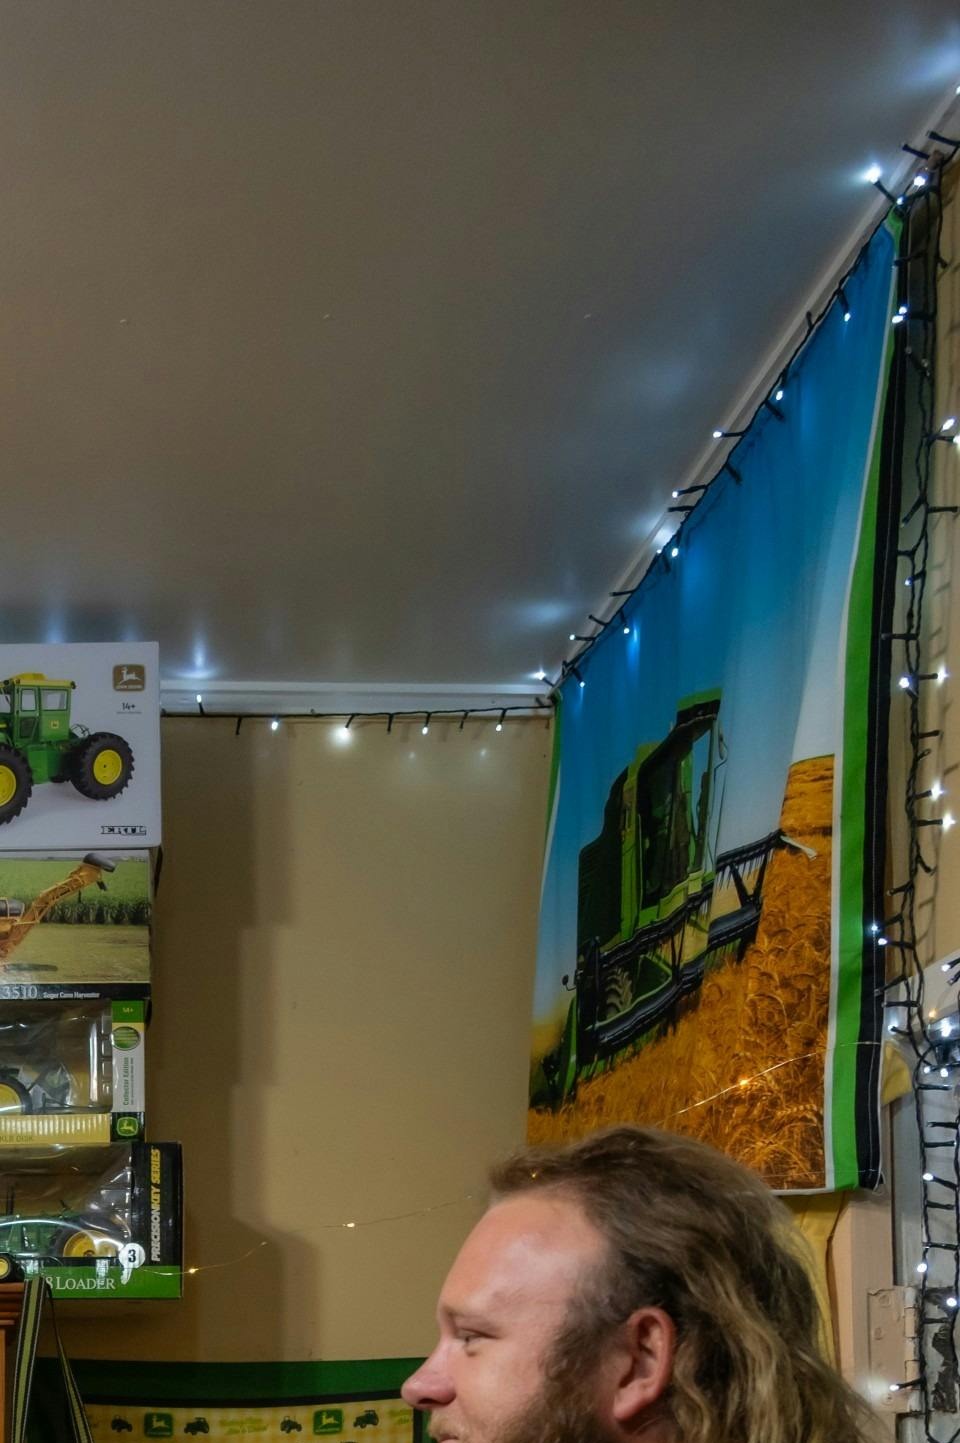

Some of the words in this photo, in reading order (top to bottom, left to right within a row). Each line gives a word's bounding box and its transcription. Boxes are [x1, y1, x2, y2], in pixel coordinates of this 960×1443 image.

[100, 825, 147, 836] ERTL
[150, 1148, 161, 1185] SERIES
[127, 1248, 137, 1263] 3
[55, 1276, 116, 1290] LOADER
